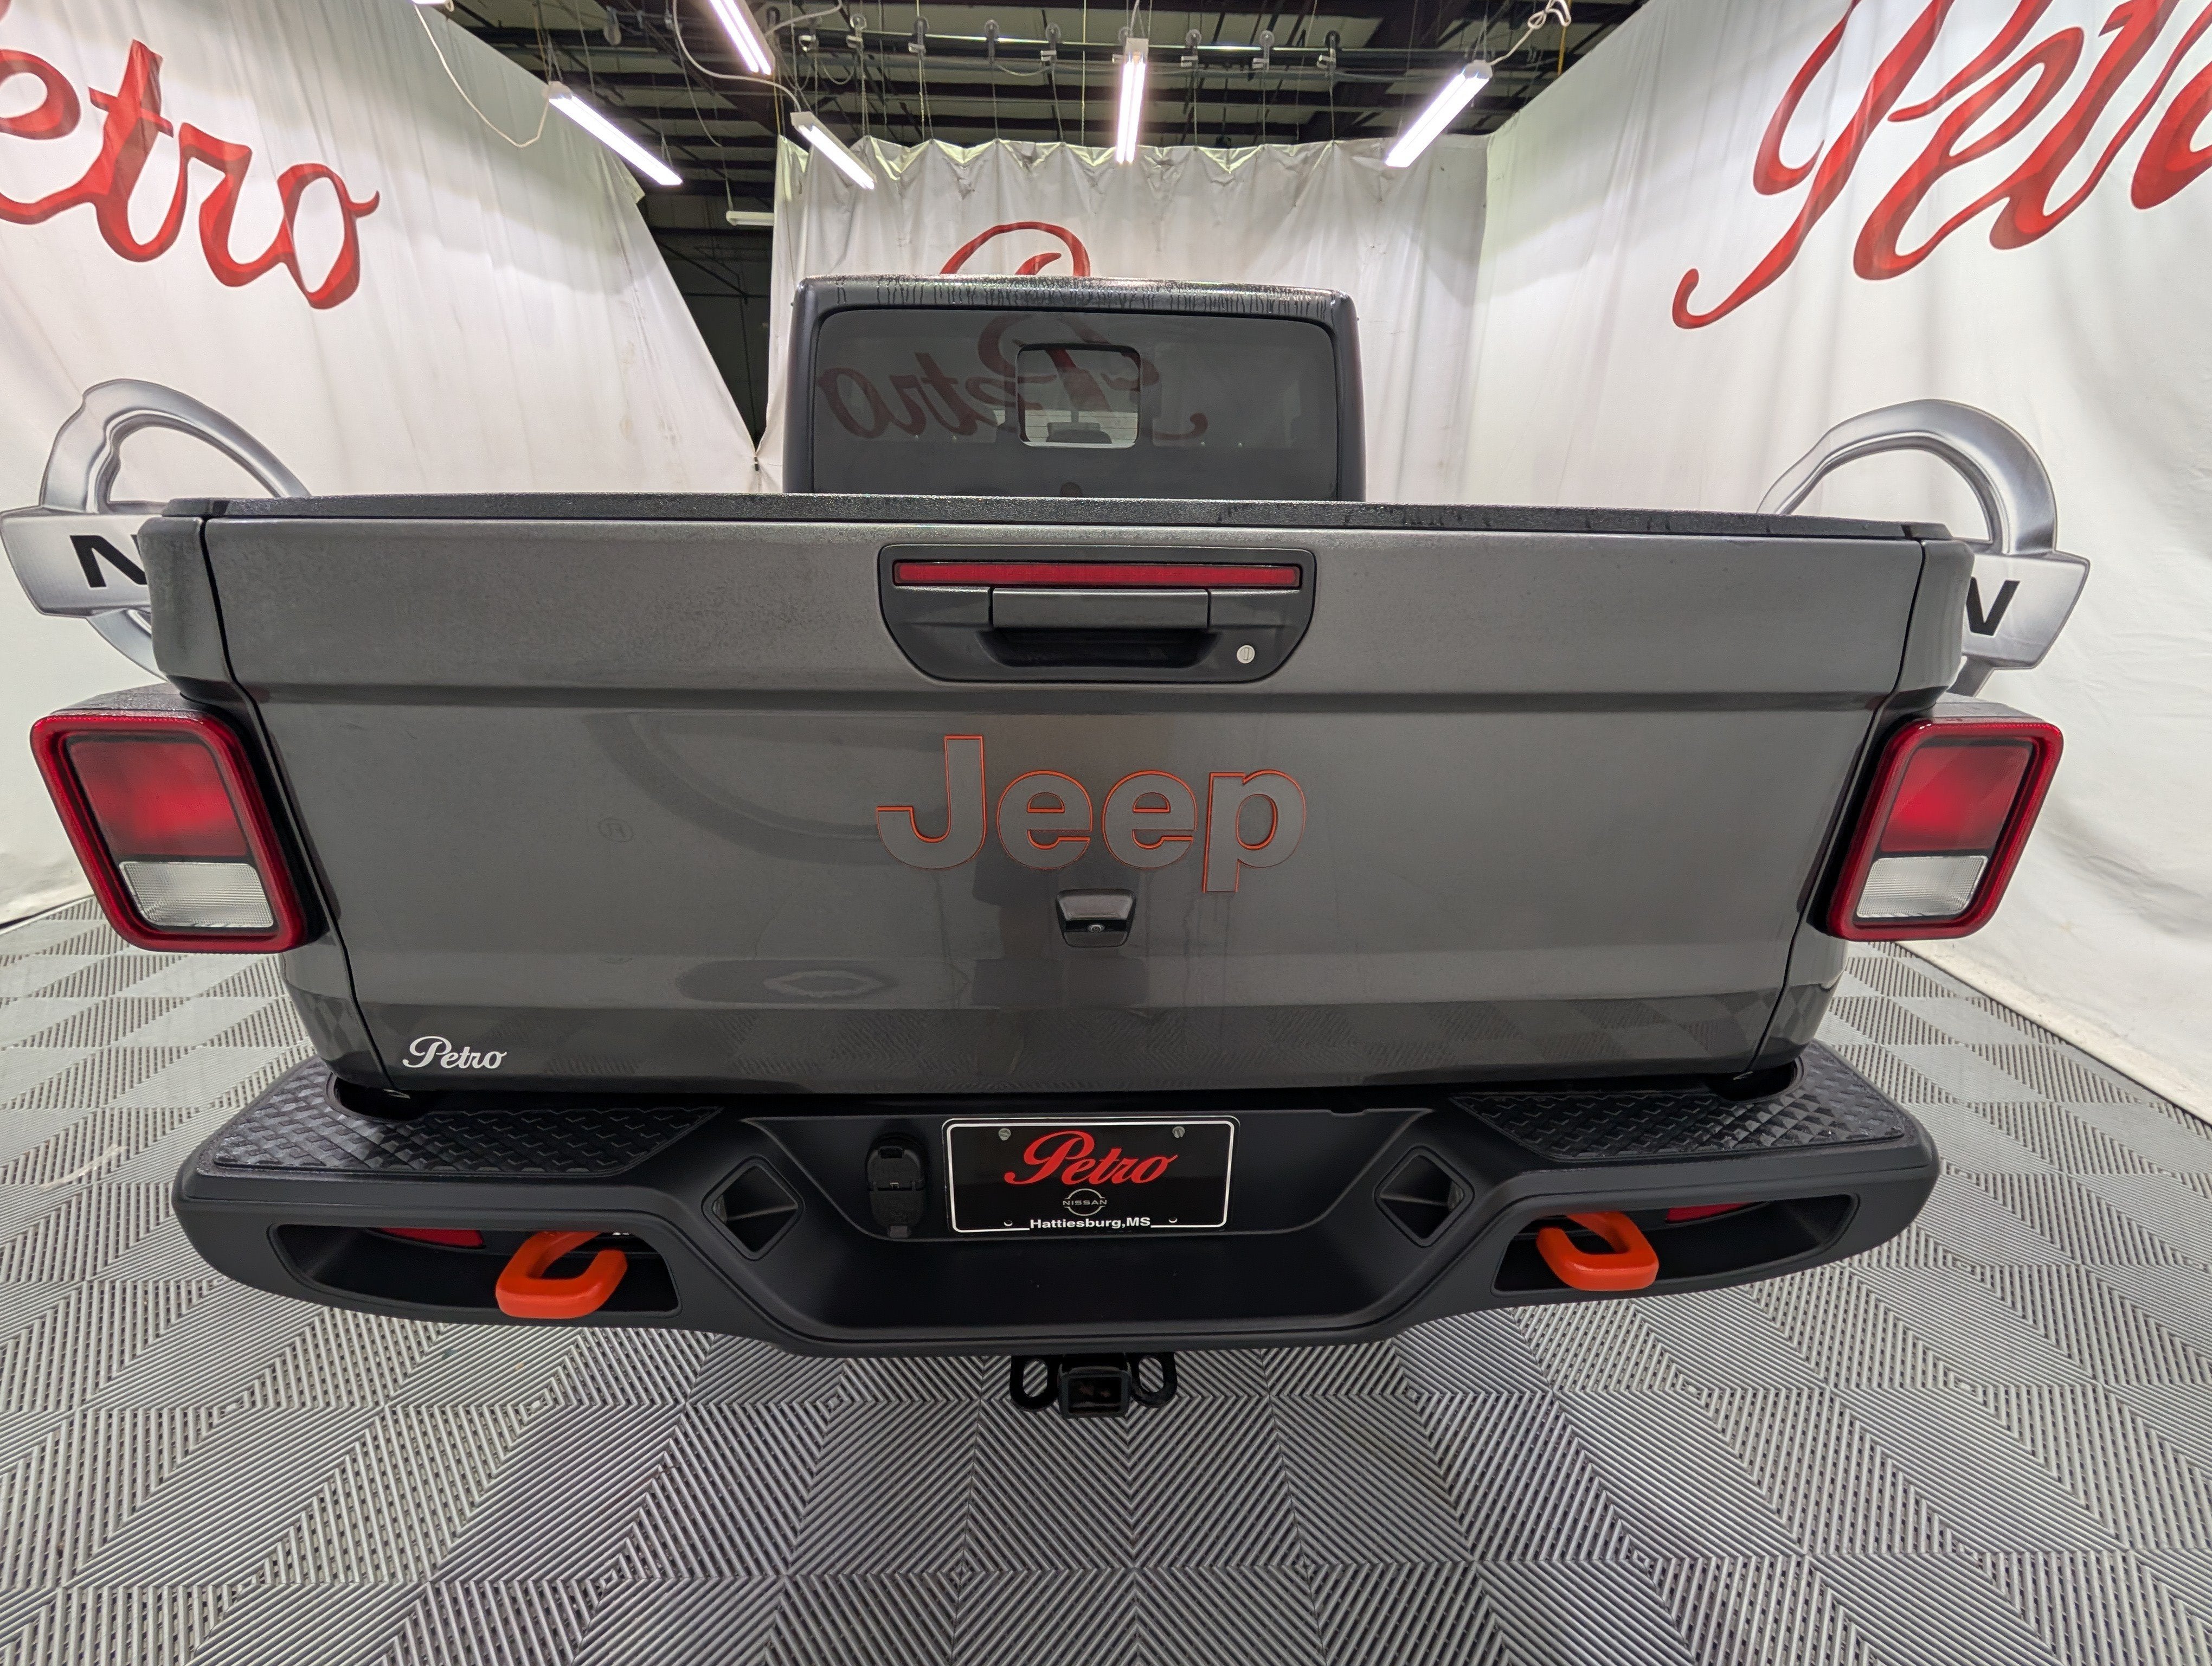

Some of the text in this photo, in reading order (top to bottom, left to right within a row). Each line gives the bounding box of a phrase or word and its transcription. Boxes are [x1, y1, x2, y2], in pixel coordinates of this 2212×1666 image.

[876, 734, 1307, 894] Jeep
[402, 1036, 507, 1069] Petro
[1004, 1131, 1178, 1184] Petro
